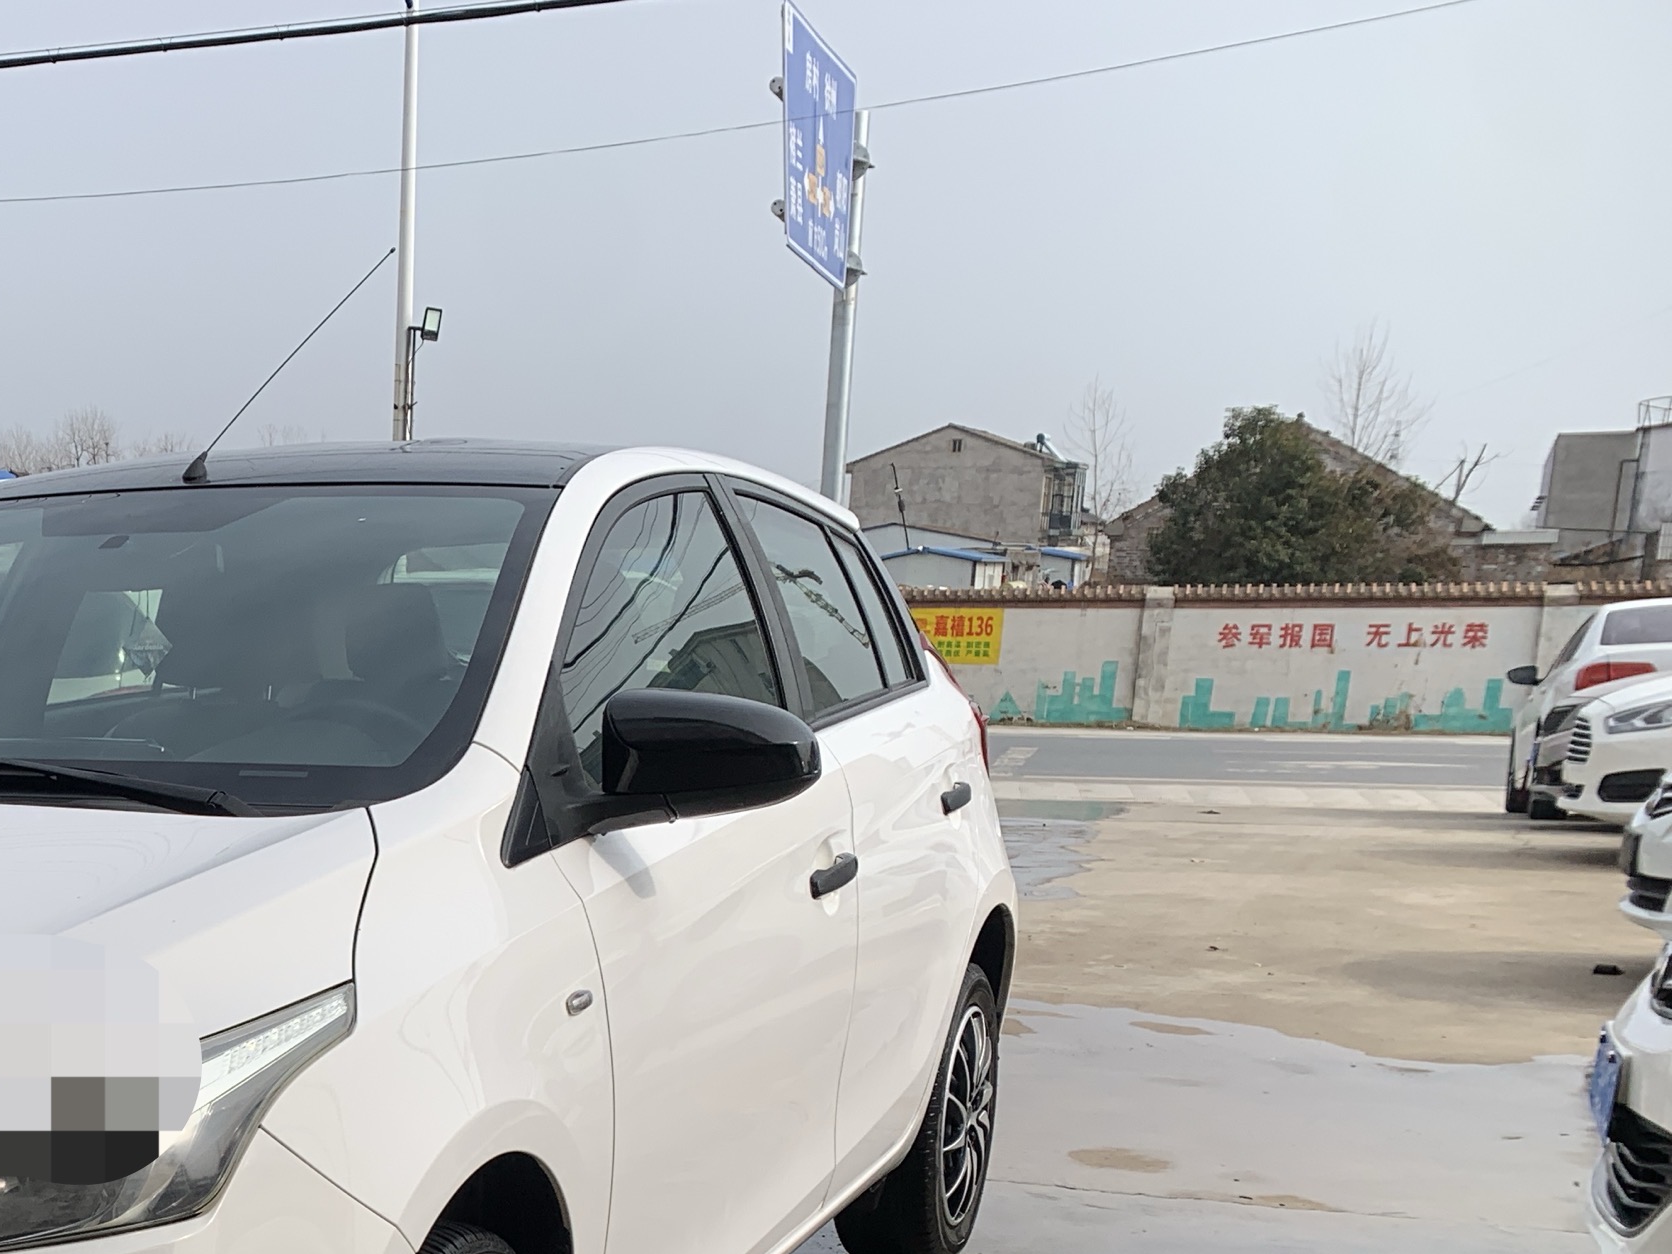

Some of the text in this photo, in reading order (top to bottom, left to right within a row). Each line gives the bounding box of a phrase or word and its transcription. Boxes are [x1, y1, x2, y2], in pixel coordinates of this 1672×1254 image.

[1217, 622, 1490, 649] 参军报国 无上光荣
